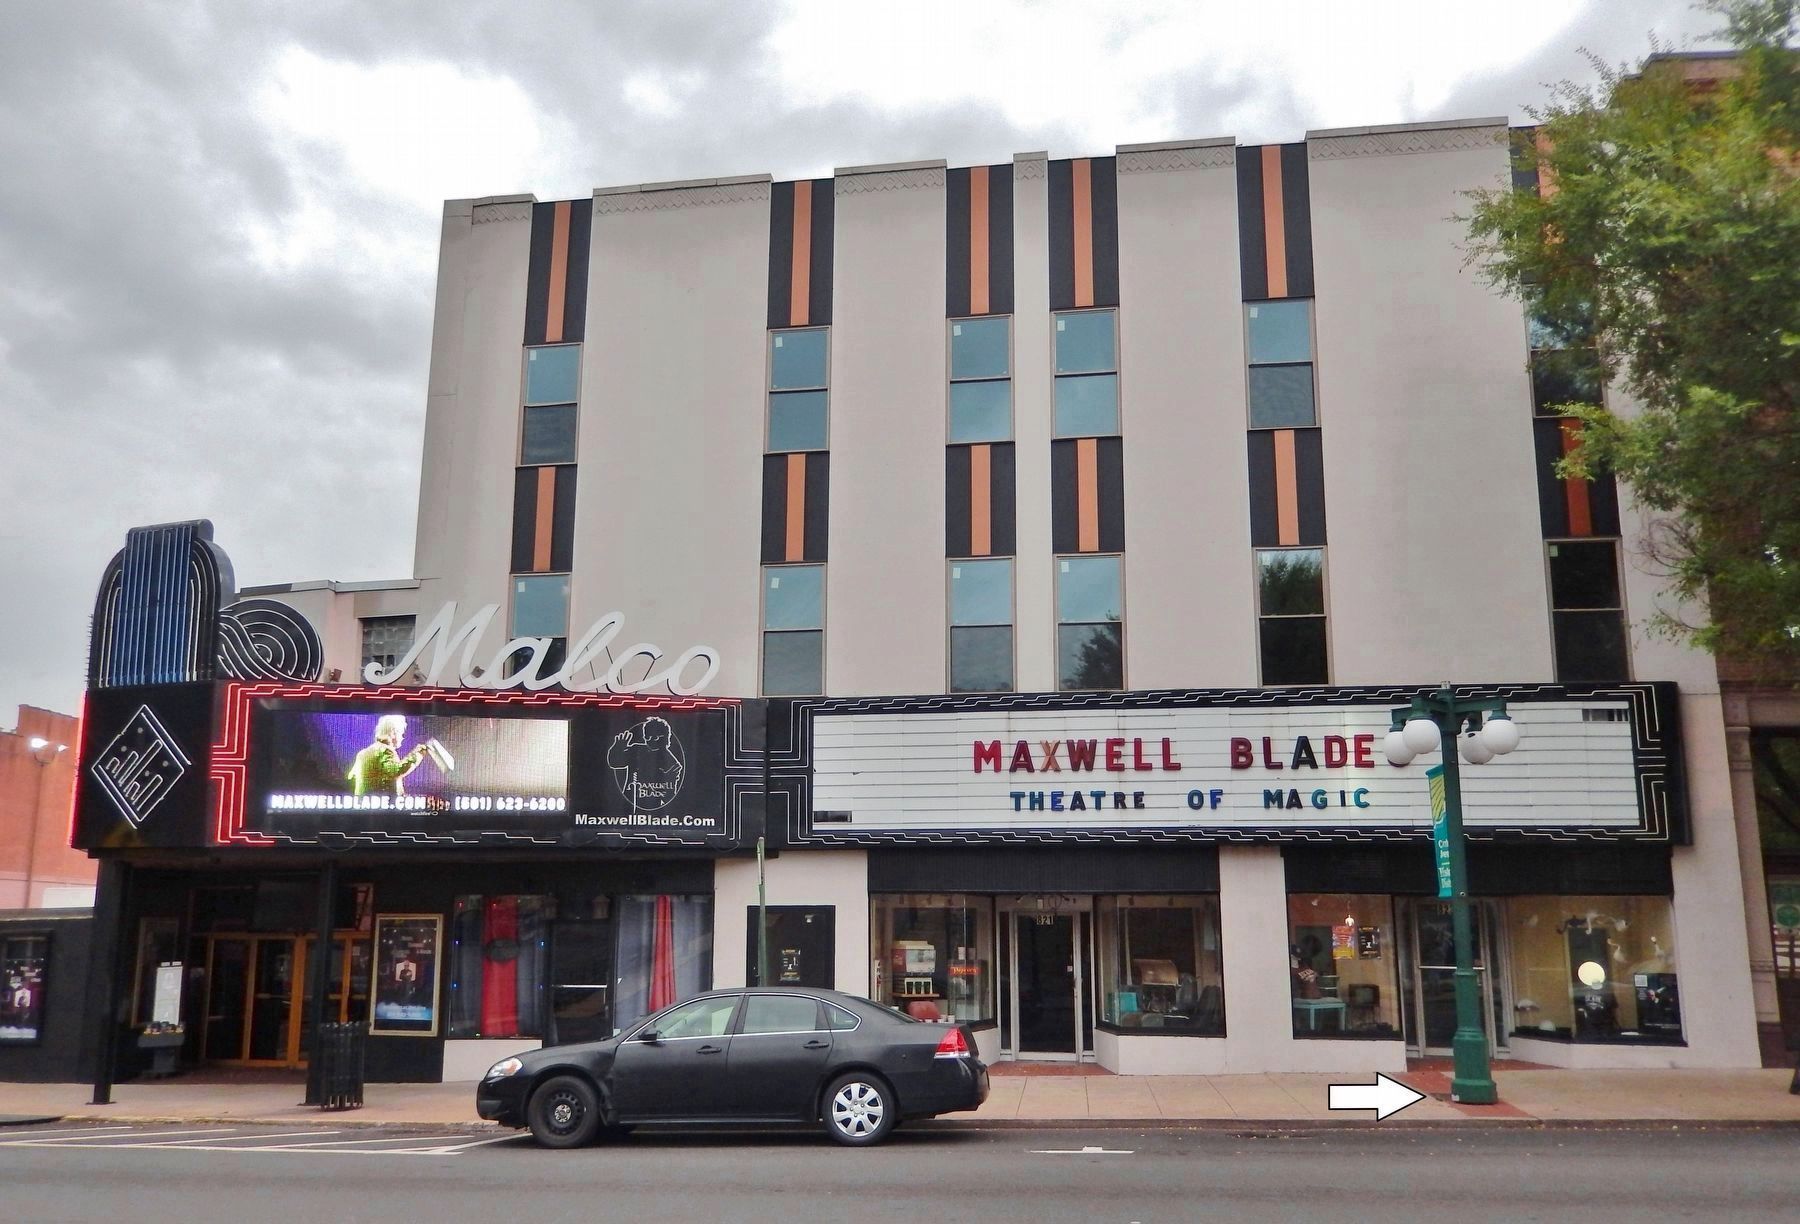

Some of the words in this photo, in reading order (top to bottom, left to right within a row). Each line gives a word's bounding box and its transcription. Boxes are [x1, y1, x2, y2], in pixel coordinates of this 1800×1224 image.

[364, 601, 721, 696] Malco
[973, 737, 1181, 773] MAXWELL
[1231, 734, 1375, 769] BLADE
[271, 795, 426, 810] MAXWELLBLADE.COM
[496, 797, 566, 811] 623-6200
[1010, 791, 1146, 811] THEATRE
[1187, 789, 1224, 811] OF
[1263, 788, 1370, 810] MAGIC
[575, 814, 715, 826] MaxwellBlade.Com
